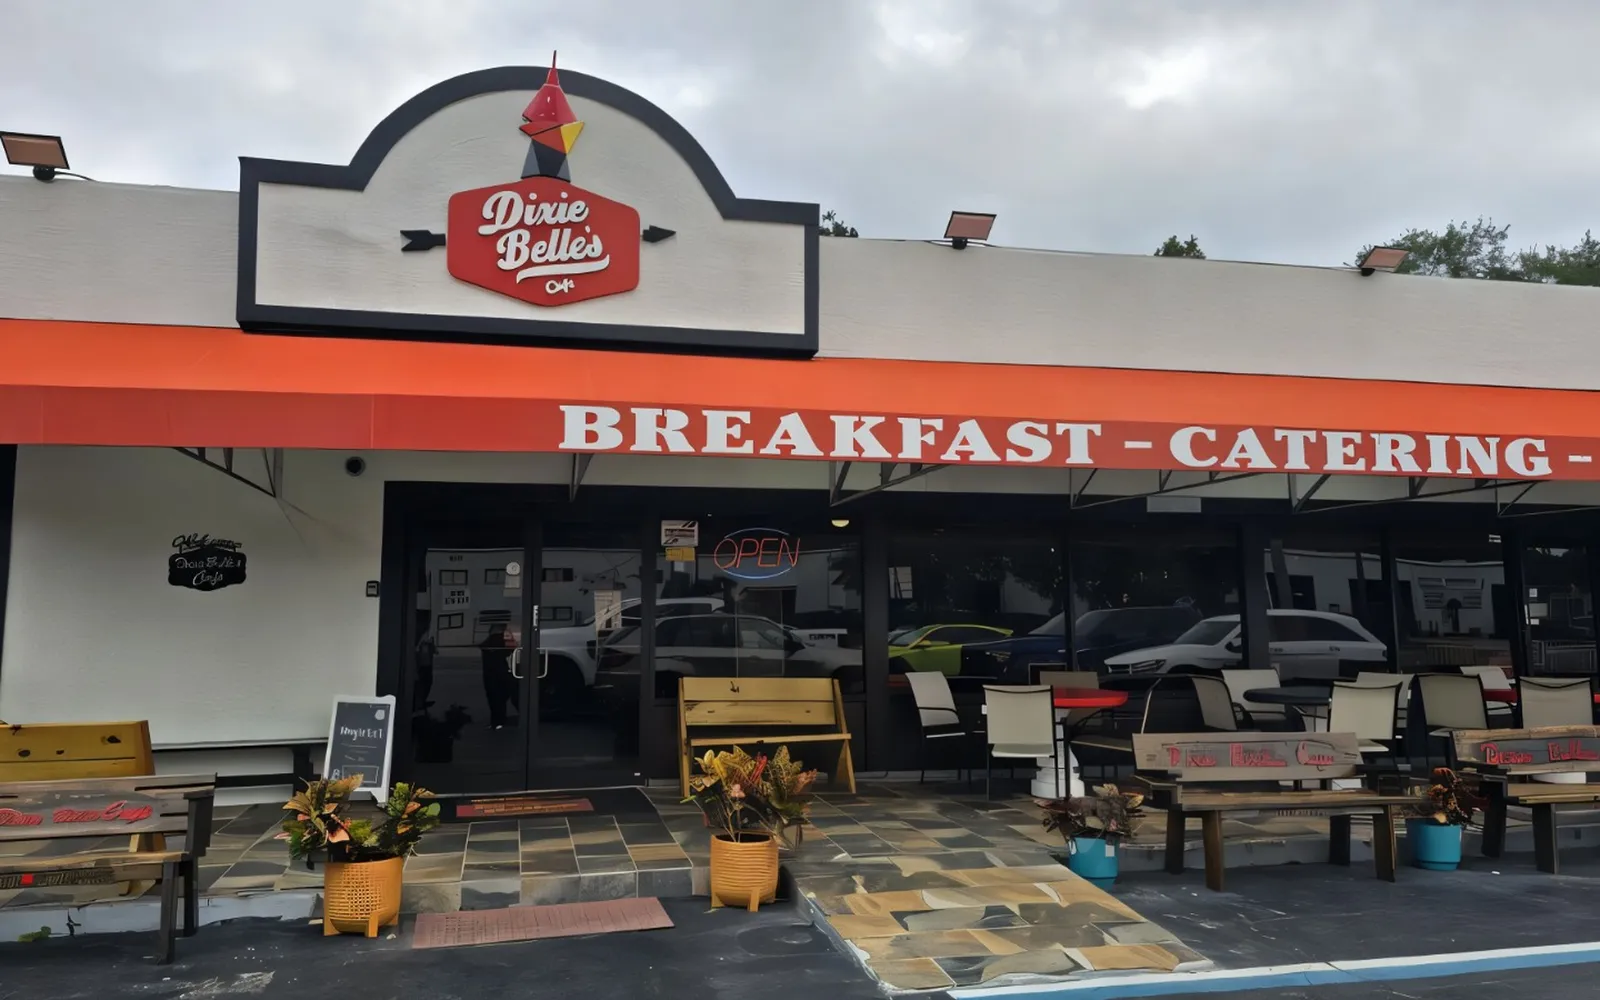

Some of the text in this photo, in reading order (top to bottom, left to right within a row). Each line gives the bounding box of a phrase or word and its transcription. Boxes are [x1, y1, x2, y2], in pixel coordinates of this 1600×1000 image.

[477, 190, 589, 236] Dixie
[496, 225, 603, 271] Belle's
[558, 404, 1102, 465] BREAKFAST
[1169, 426, 1553, 477] CATERING
[713, 537, 801, 569] OPEN
